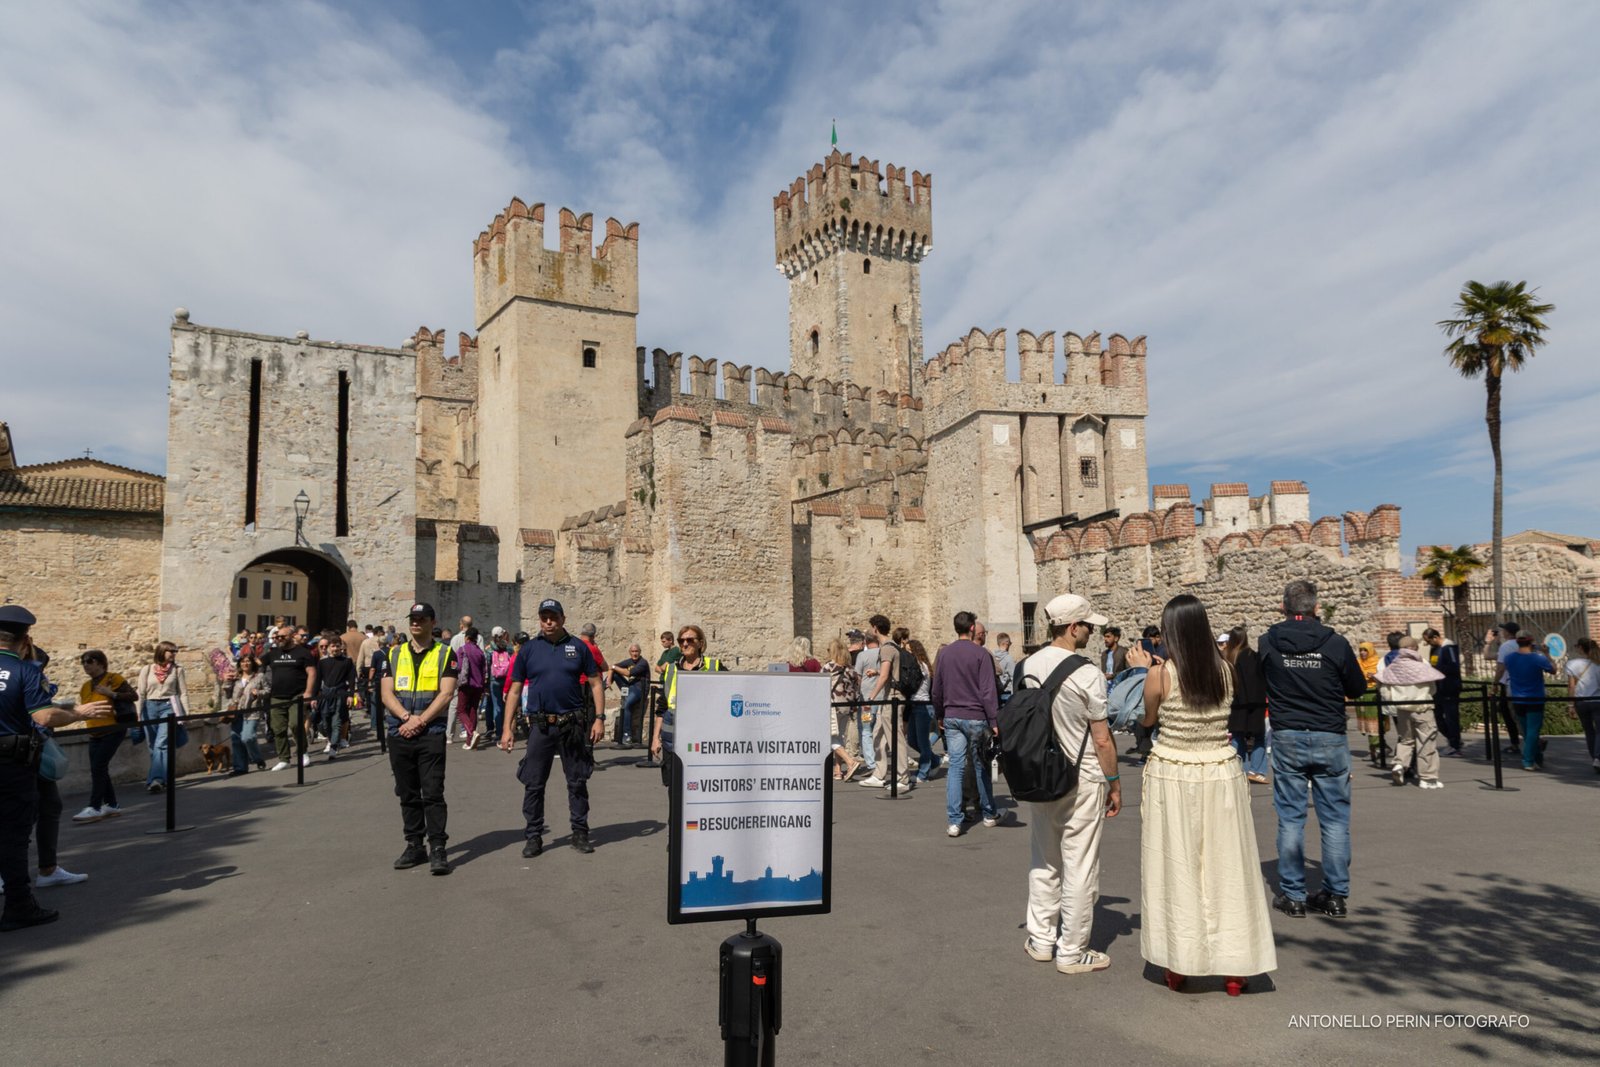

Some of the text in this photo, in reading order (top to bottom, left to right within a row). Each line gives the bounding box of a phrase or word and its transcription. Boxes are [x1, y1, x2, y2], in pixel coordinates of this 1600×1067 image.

[1283, 659, 1321, 669] SERVIZI
[701, 740, 821, 754] ENTRATA VISITATORI
[700, 777, 821, 792] VISITORS' ENTRANCE
[699, 815, 812, 831] BESUCHEREINGANG
